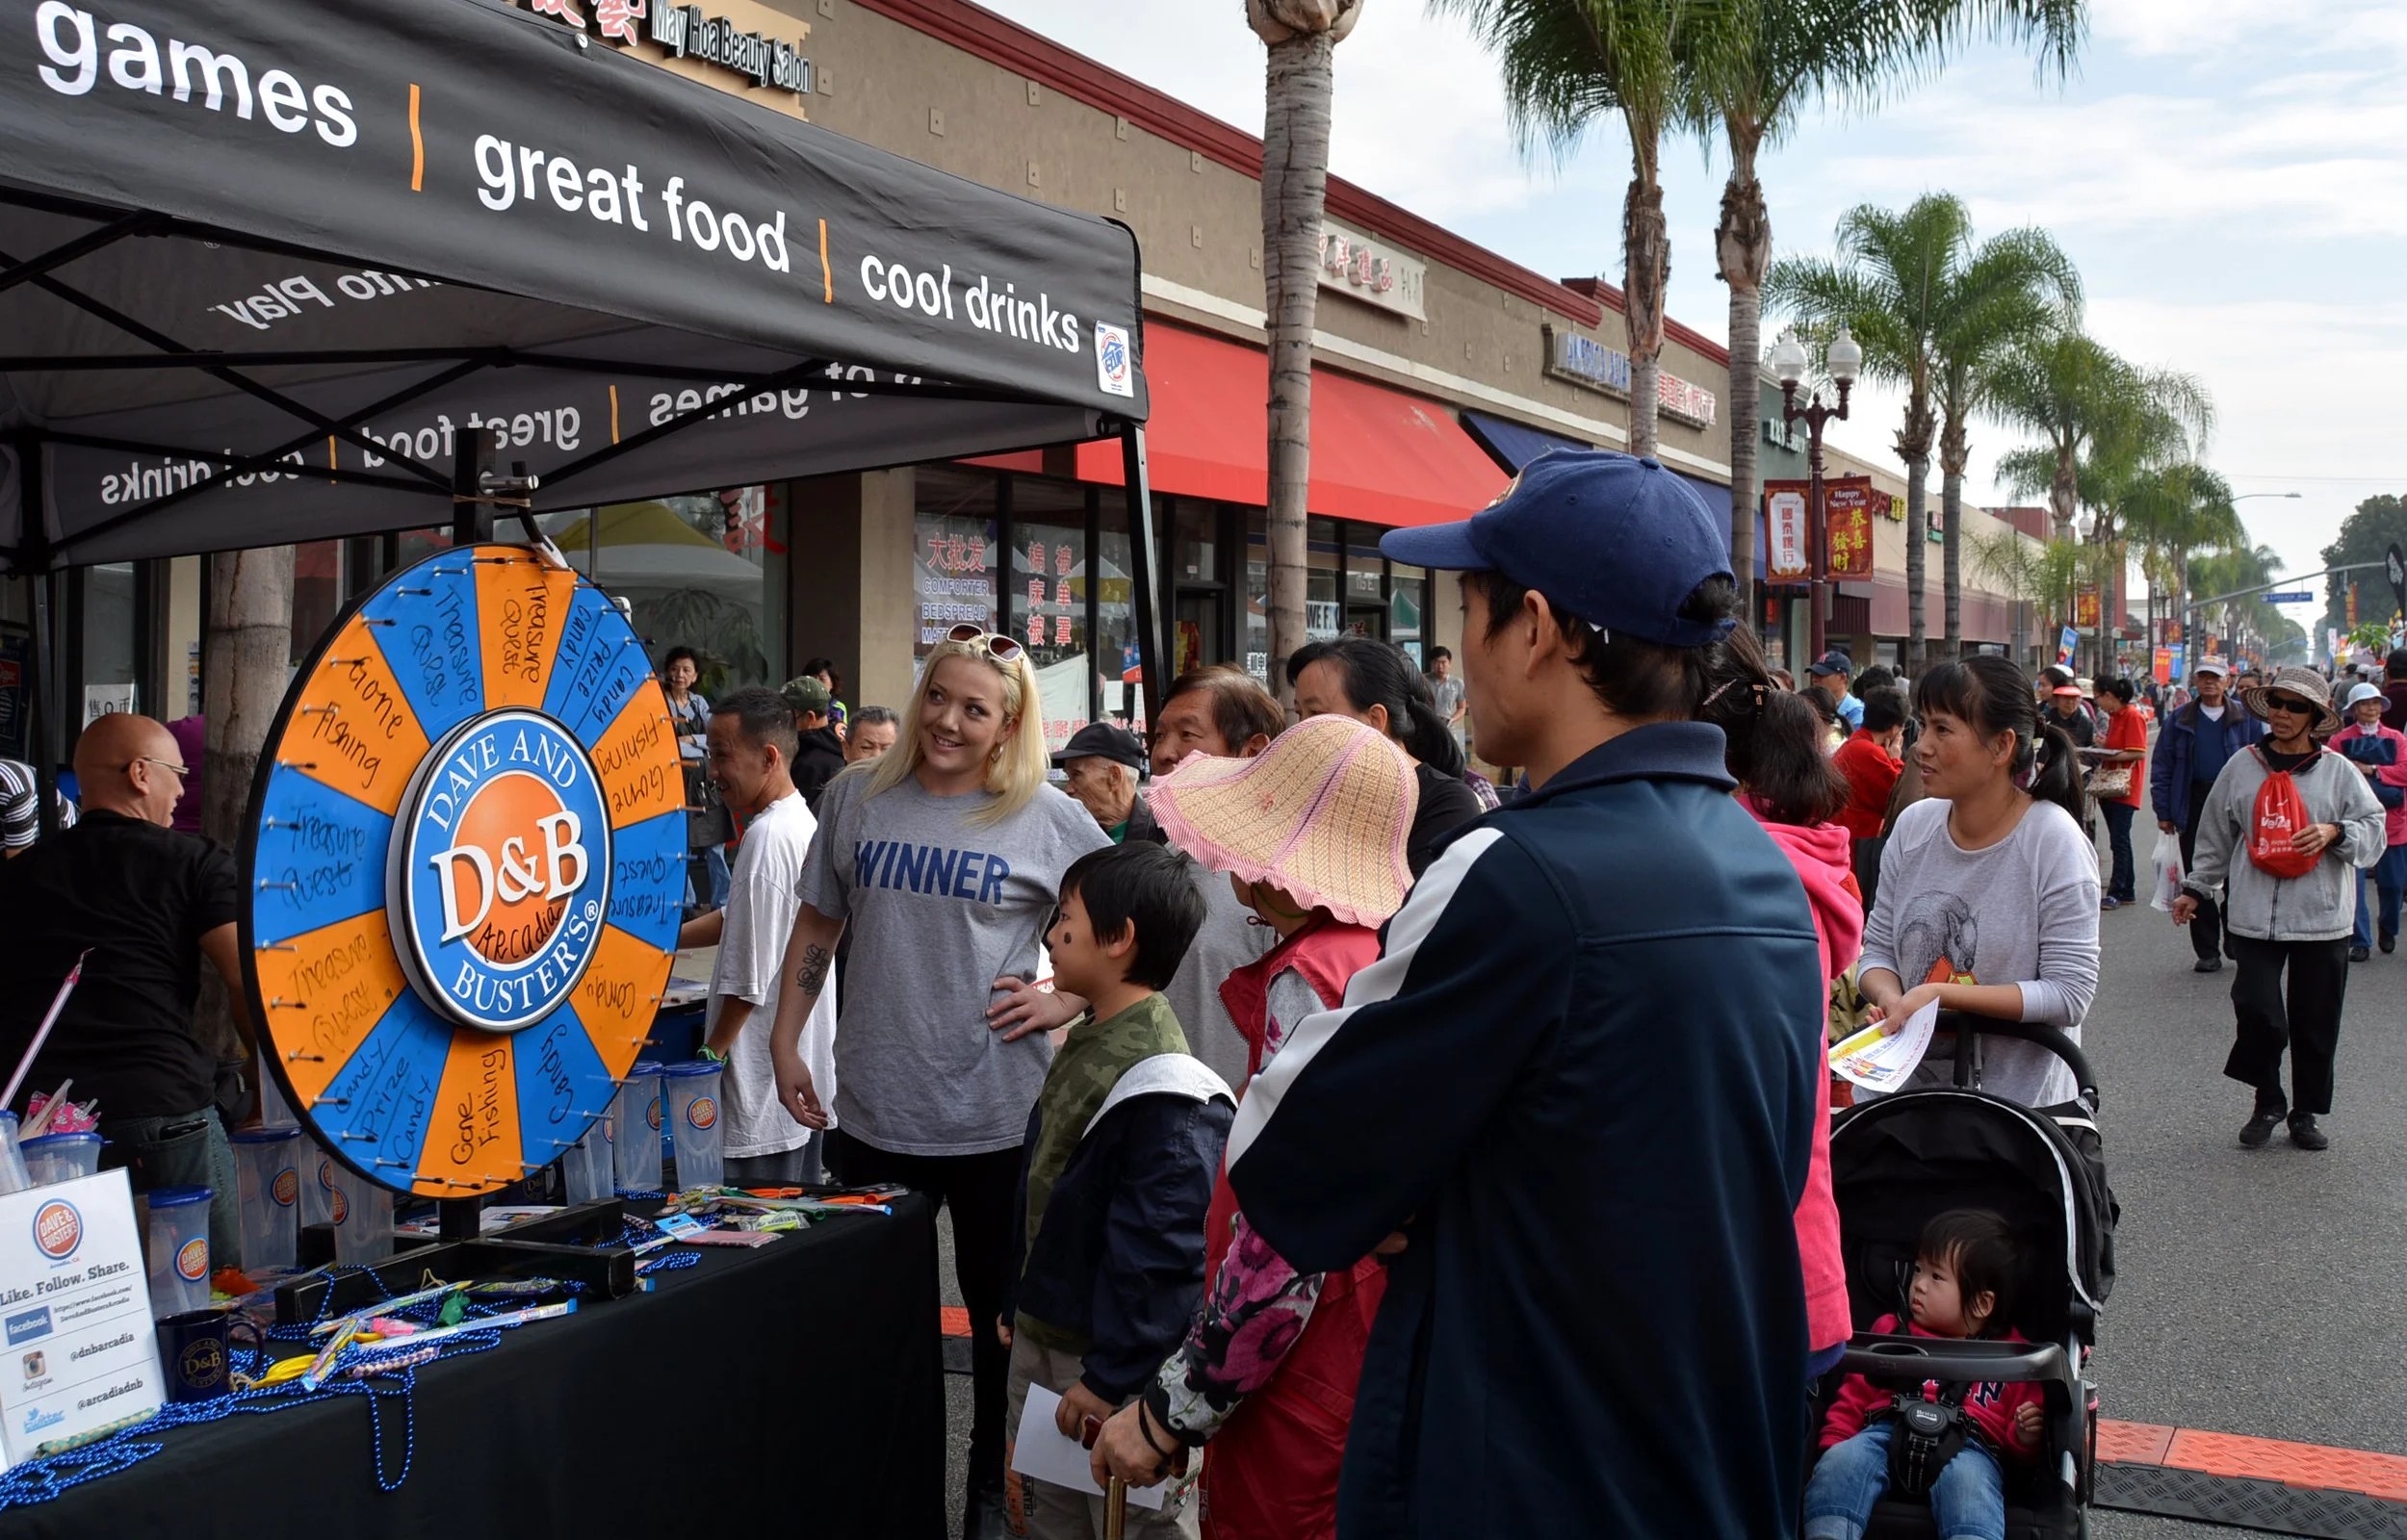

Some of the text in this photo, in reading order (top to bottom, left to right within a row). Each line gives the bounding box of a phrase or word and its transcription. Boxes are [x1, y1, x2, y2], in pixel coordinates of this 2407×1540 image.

[652, 0, 812, 93] May Hoa Beauty Salon
[36, 0, 358, 148] games
[474, 133, 790, 274] great food
[860, 254, 1079, 353] cool drinks
[1829, 500, 1847, 508] New
[1834, 491, 1860, 500] Happy
[927, 531, 987, 574] 大批发
[1832, 530, 1851, 572] 發財
[1849, 507, 1869, 551] 恭喜
[923, 577, 990, 598] COMFORTER
[526, 579, 550, 684] Treasure
[921, 602, 988, 622] BEDSPREAD
[1307, 604, 1321, 629] WE
[500, 599, 522, 675] Quest
[410, 624, 449, 707] Quest
[348, 656, 403, 739] Gone
[427, 729, 578, 833] DAVE AND
[290, 802, 367, 860] Treasure
[281, 860, 354, 911] Quest
[430, 809, 589, 943] D&B
[854, 840, 1010, 906] WINNER
[478, 1047, 506, 1147] Fishing
[450, 1091, 475, 1166] Gone
[39, 1208, 74, 1238] DAVE &
[181, 1245, 203, 1265] DAVE
[0, 1260, 130, 1306] Like. Follow. Share.
[8, 1314, 49, 1336] facebook
[70, 1331, 135, 1362] @dnbarcadia
[184, 1352, 221, 1375] D&B
[77, 1377, 143, 1411] @arcadiadnb
